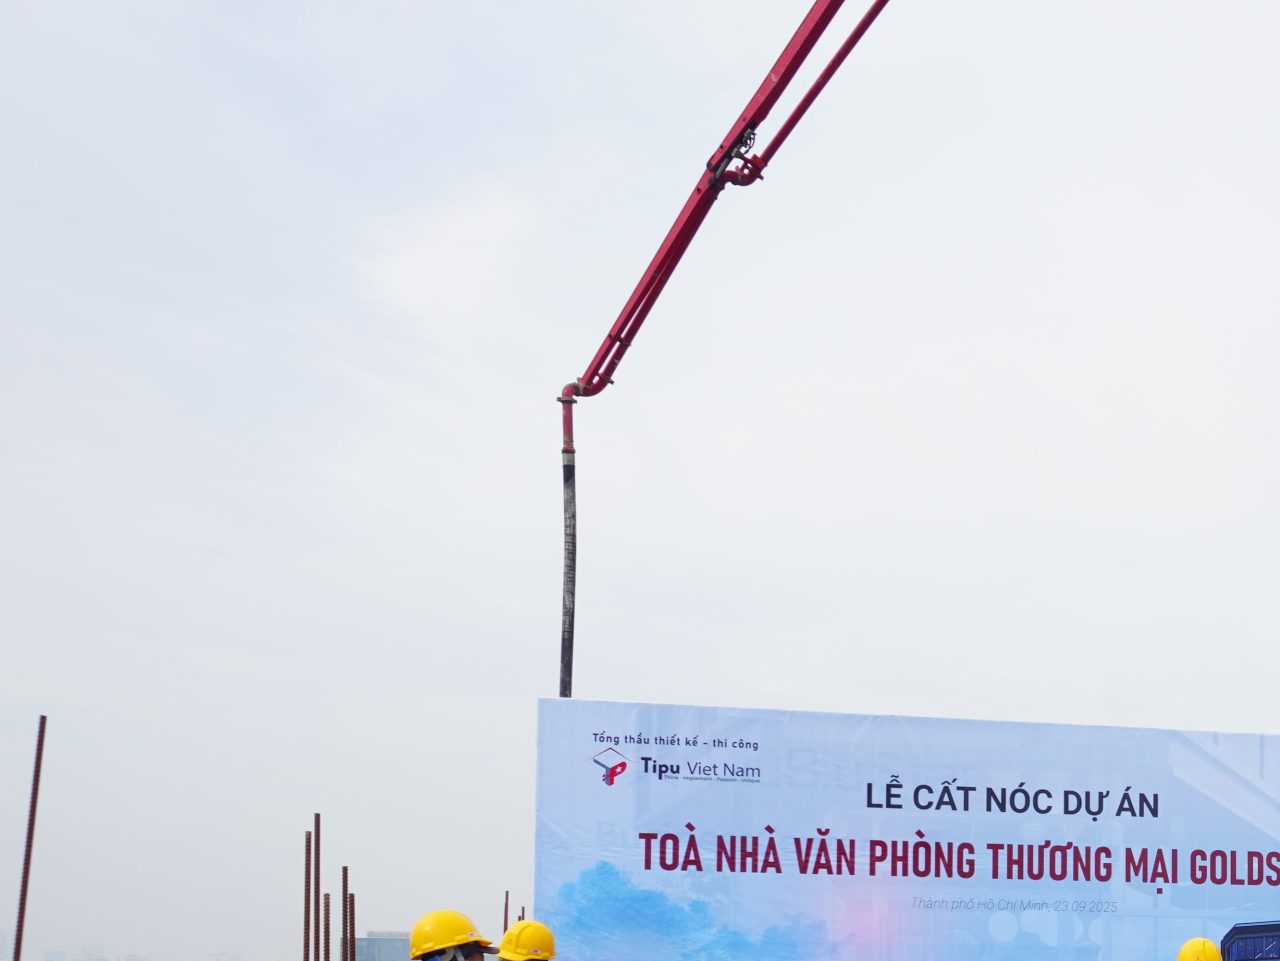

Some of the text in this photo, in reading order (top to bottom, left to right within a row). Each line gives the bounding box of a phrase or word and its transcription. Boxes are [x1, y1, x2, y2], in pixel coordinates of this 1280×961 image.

[592, 731, 620, 746] Tổng
[624, 732, 650, 745] thầu
[654, 734, 681, 747] thiết
[685, 735, 699, 747] kế
[712, 739, 728, 748] thi
[731, 739, 759, 752] công
[640, 756, 761, 780] Tipu Viet Nam
[866, 774, 1159, 822] LỄ CẤT NÓC DỰ ÁN
[638, 821, 704, 872] TOÀ
[716, 824, 783, 875] NHÀ
[793, 827, 856, 876] VĂN
[869, 828, 976, 879] PHÒNG
[986, 839, 1113, 883] THƯƠNG
[1124, 847, 1178, 895] MẠI
[911, 896, 950, 911] Thành
[950, 897, 975, 913] phố
[1053, 900, 1120, 914] 23.09.2025
